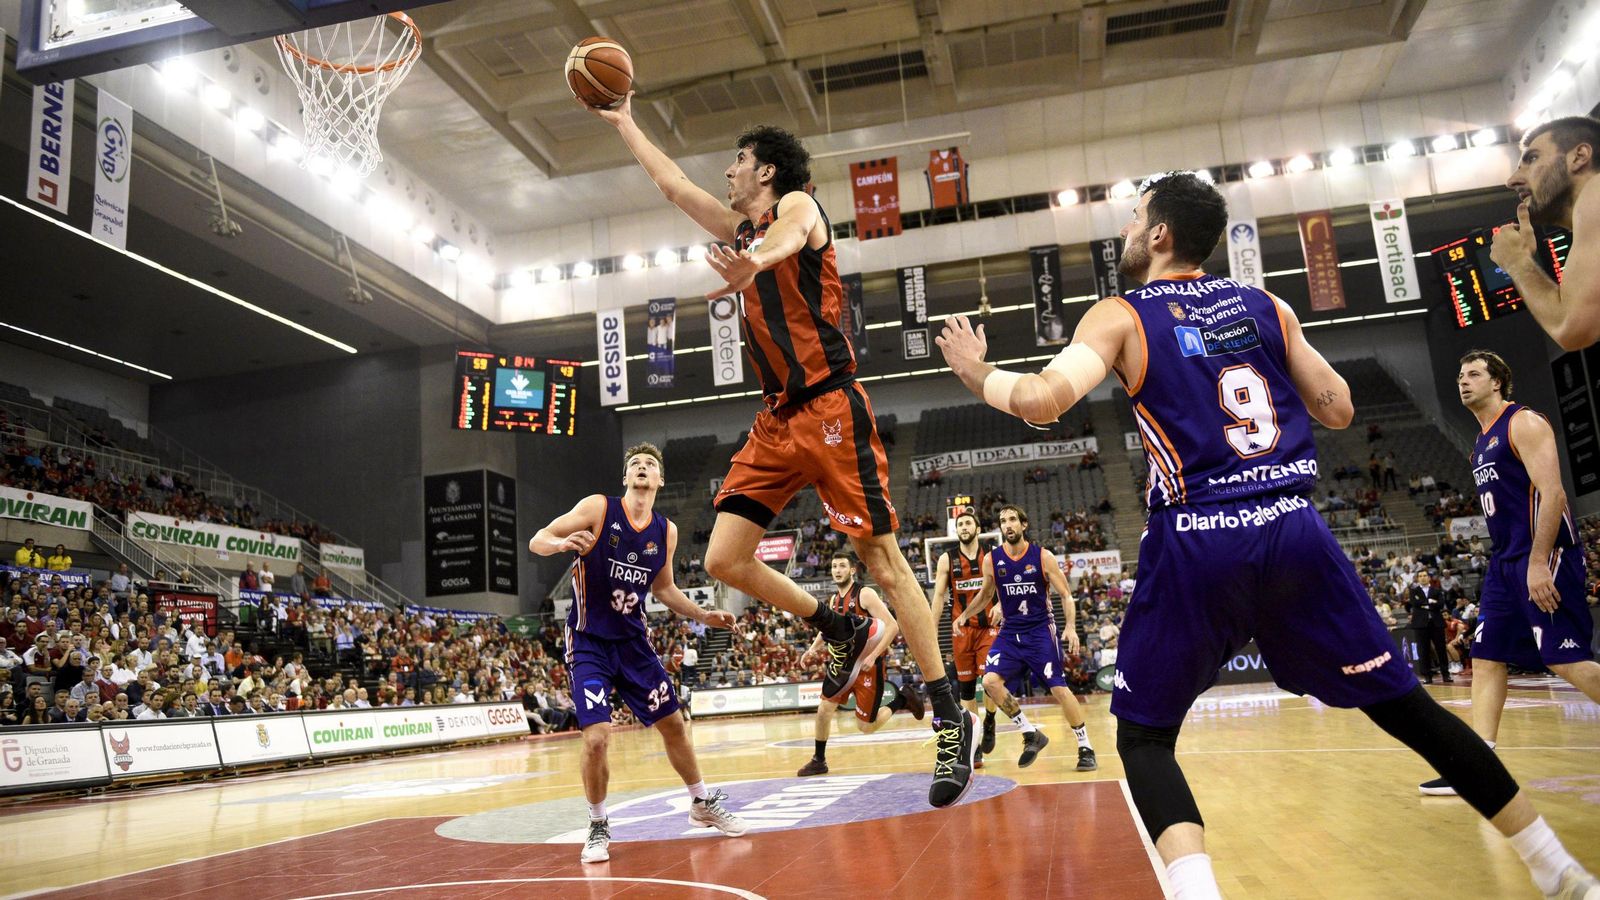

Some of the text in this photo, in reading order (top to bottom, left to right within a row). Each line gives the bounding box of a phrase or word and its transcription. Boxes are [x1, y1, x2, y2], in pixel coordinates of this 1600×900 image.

[39, 79, 65, 176] BERNE
[856, 171, 893, 187] CAMPEÓN
[1382, 225, 1407, 298] fertisac
[1448, 246, 1465, 261] 59
[905, 278, 915, 312] VERDAD
[912, 267, 927, 323] BURGERS
[603, 317, 621, 379] asisa
[718, 325, 737, 381] otero
[1217, 362, 1281, 460] 9
[975, 446, 1030, 463] IDEAL
[1037, 440, 1092, 456] IDEAL
[914, 453, 969, 473] IDEAL
[428, 503, 482, 515] AYUNTAMIENTO
[1480, 490, 1496, 519] 10
[443, 513, 477, 522] GRANADA
[1176, 513, 1239, 532] Diario
[132, 520, 298, 560] COVIRAN COVIRAN
[323, 550, 363, 566] COVIRAN
[608, 557, 652, 586] TRAPA
[1003, 582, 1038, 596] TRAPA
[611, 588, 639, 615] 32
[1018, 600, 1028, 615] 4
[1043, 662, 1053, 679] 4
[1341, 651, 1391, 675] Kappa
[648, 681, 670, 712] 32
[383, 718, 433, 738] COVIRAN
[447, 715, 482, 728] DEKTON
[313, 722, 374, 744] COVIRAN
[24, 744, 69, 756] Diputación
[26, 755, 71, 767] de Granada
